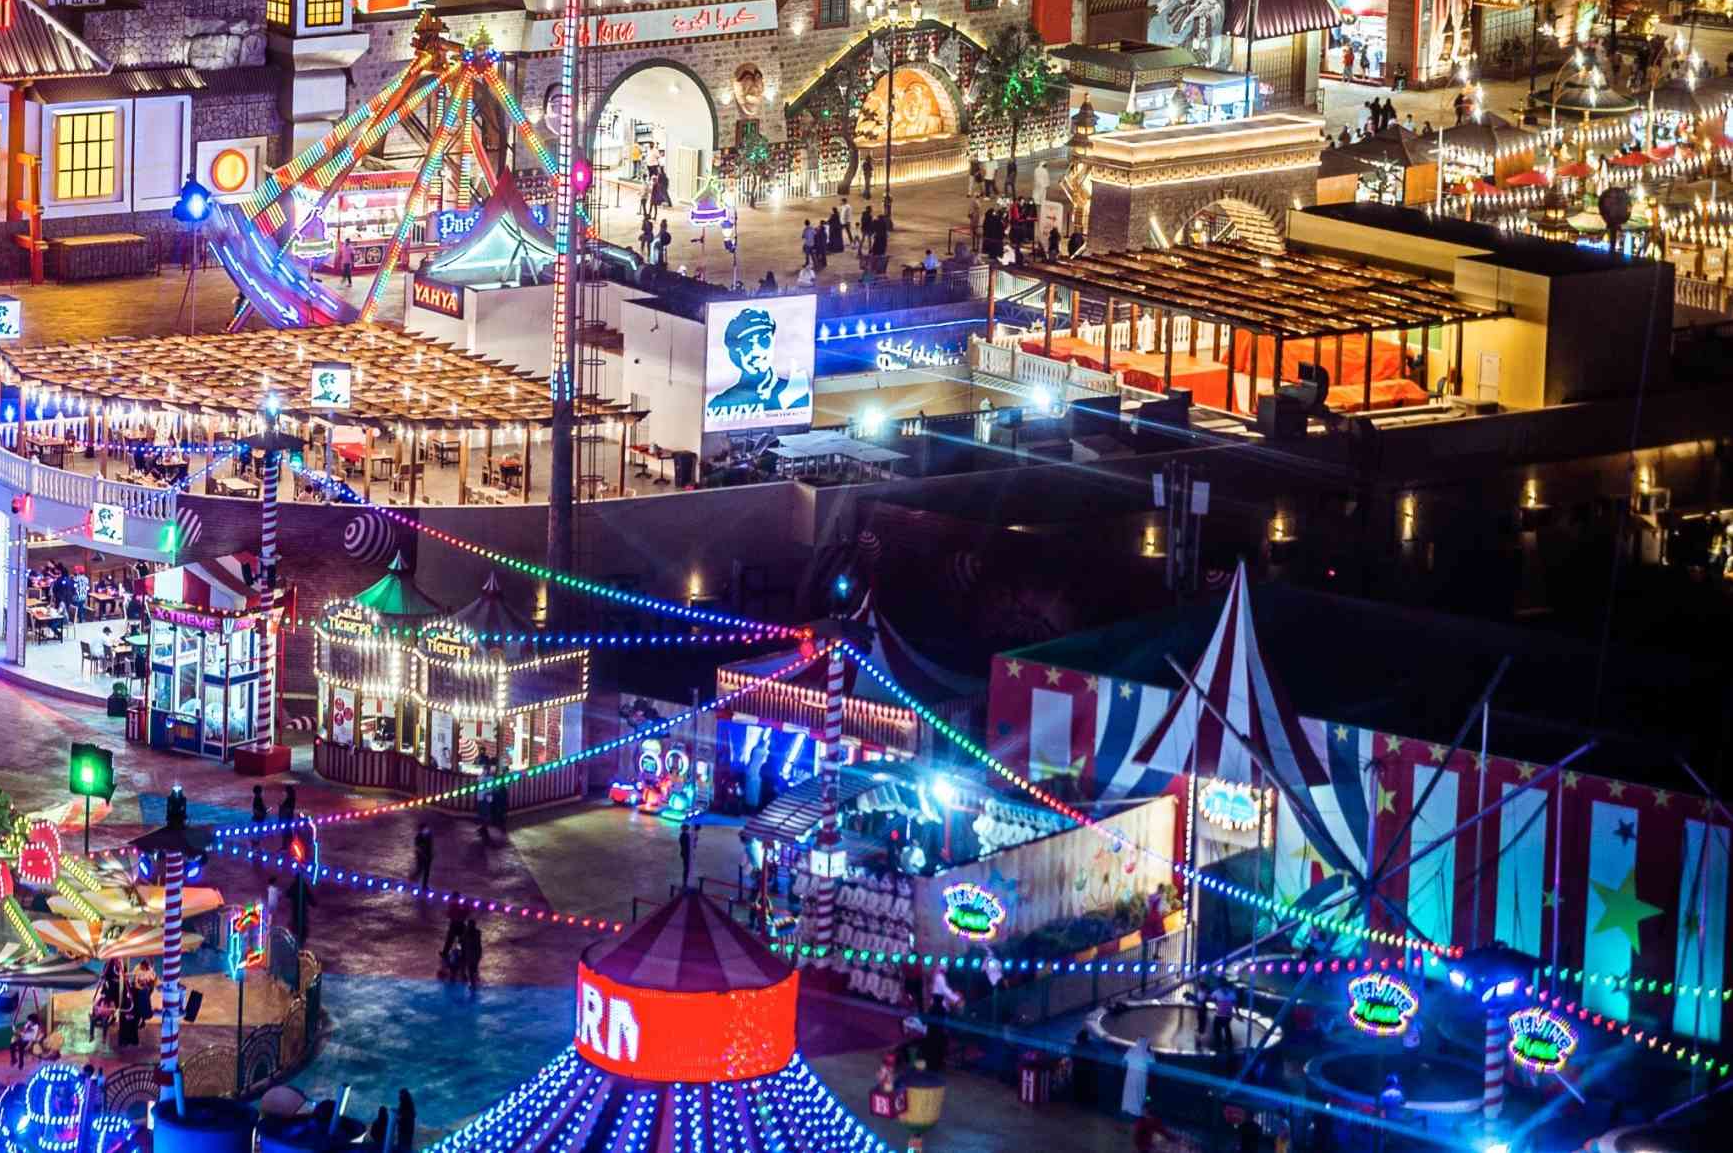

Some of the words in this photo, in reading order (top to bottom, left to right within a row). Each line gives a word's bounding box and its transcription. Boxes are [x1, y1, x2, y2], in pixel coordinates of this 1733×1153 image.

[413, 281, 460, 313] YAHYA
[705, 402, 766, 423] YAHYA
[329, 615, 373, 637] TICKETS
[426, 637, 471, 660] TICKETS
